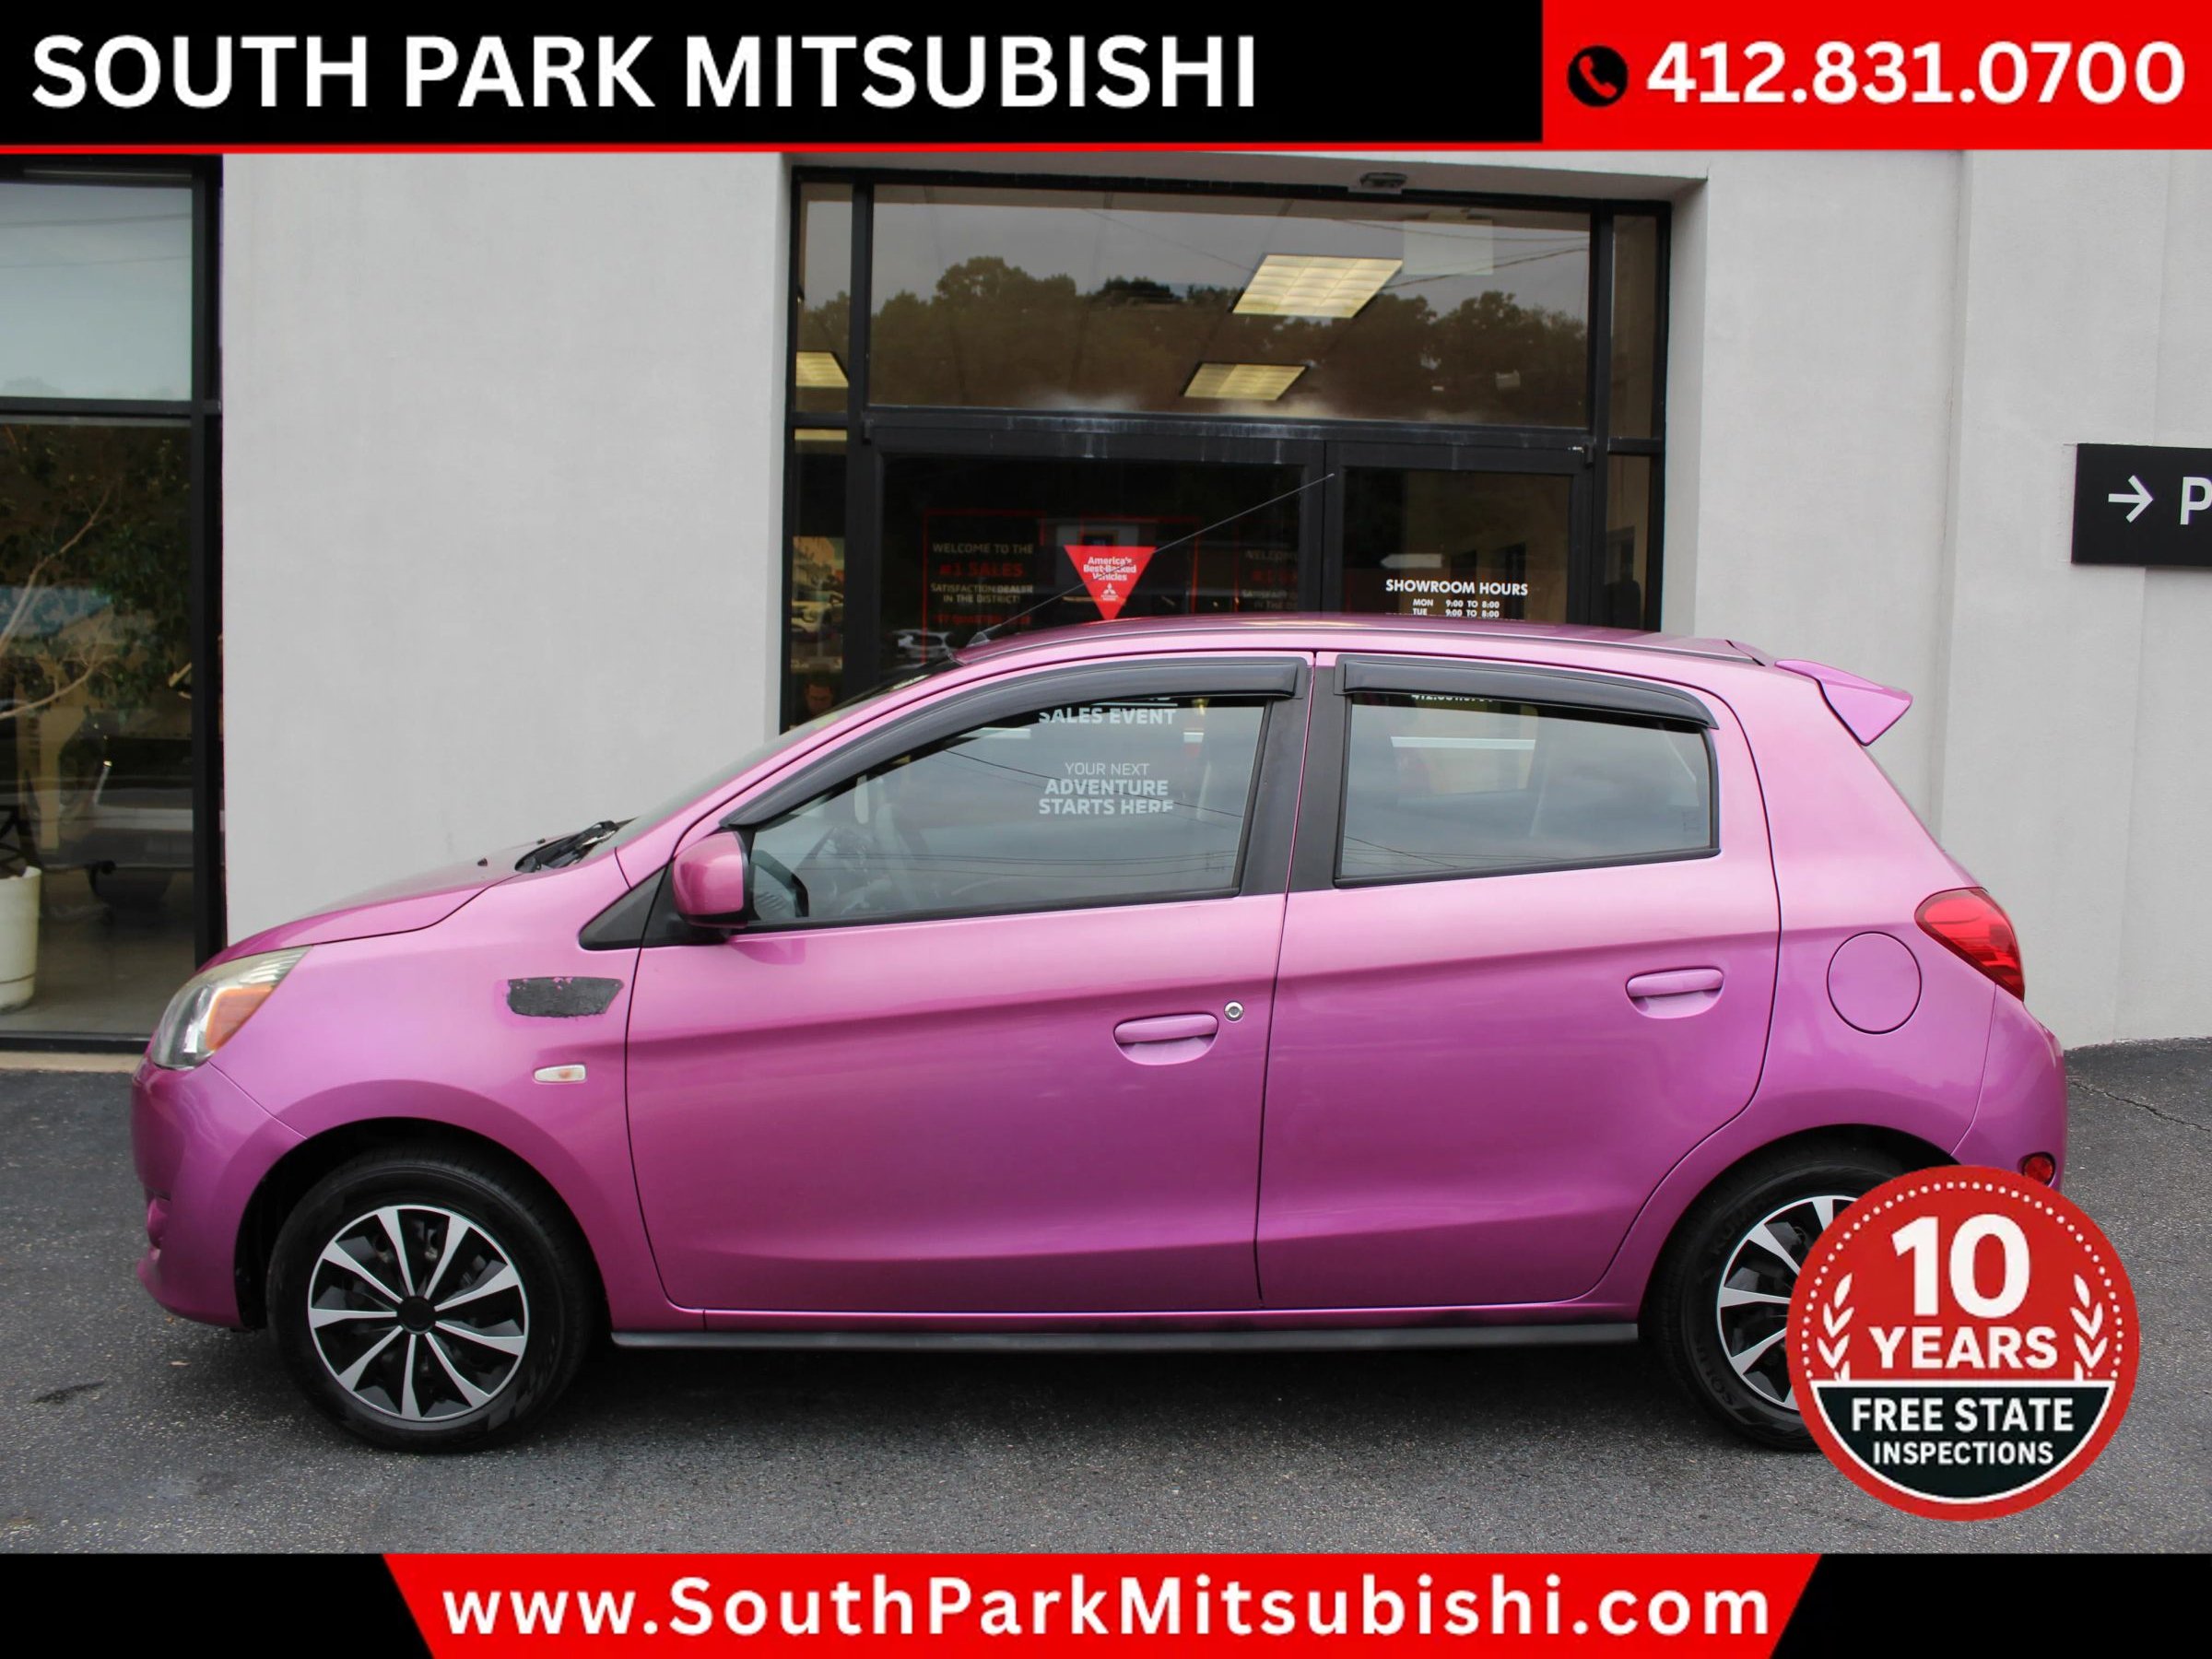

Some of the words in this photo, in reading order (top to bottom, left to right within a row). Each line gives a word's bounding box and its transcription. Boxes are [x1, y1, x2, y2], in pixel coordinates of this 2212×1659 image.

[932, 542, 990, 554] WELCOME
[994, 543, 1009, 554] TO
[1013, 543, 1033, 555] THE
[1088, 557, 1132, 565] America's
[1083, 564, 1136, 573] Best-Backed
[1092, 572, 1128, 581] Vehicles
[930, 582, 993, 593] SATISFACTION
[1385, 579, 1476, 594] SHOWROOM
[1478, 582, 1528, 596] HOURS
[943, 594, 953, 603] IN
[956, 594, 973, 604] THE
[1412, 598, 1434, 606] MON
[1445, 599, 1464, 608] 9:00
[1466, 600, 1478, 608] TO
[1481, 601, 1500, 609] 8:00
[1445, 608, 1463, 618] 9:00
[1466, 609, 1477, 618] TO
[1481, 609, 1500, 618] 8:00
[1039, 707, 1103, 724] SALES
[1109, 708, 1176, 724] EVENT
[1065, 762, 1106, 775] YOUR
[1111, 763, 1150, 776] NEXT
[1044, 779, 1169, 796] ADVENTURE
[1039, 798, 1115, 815] STARTS
